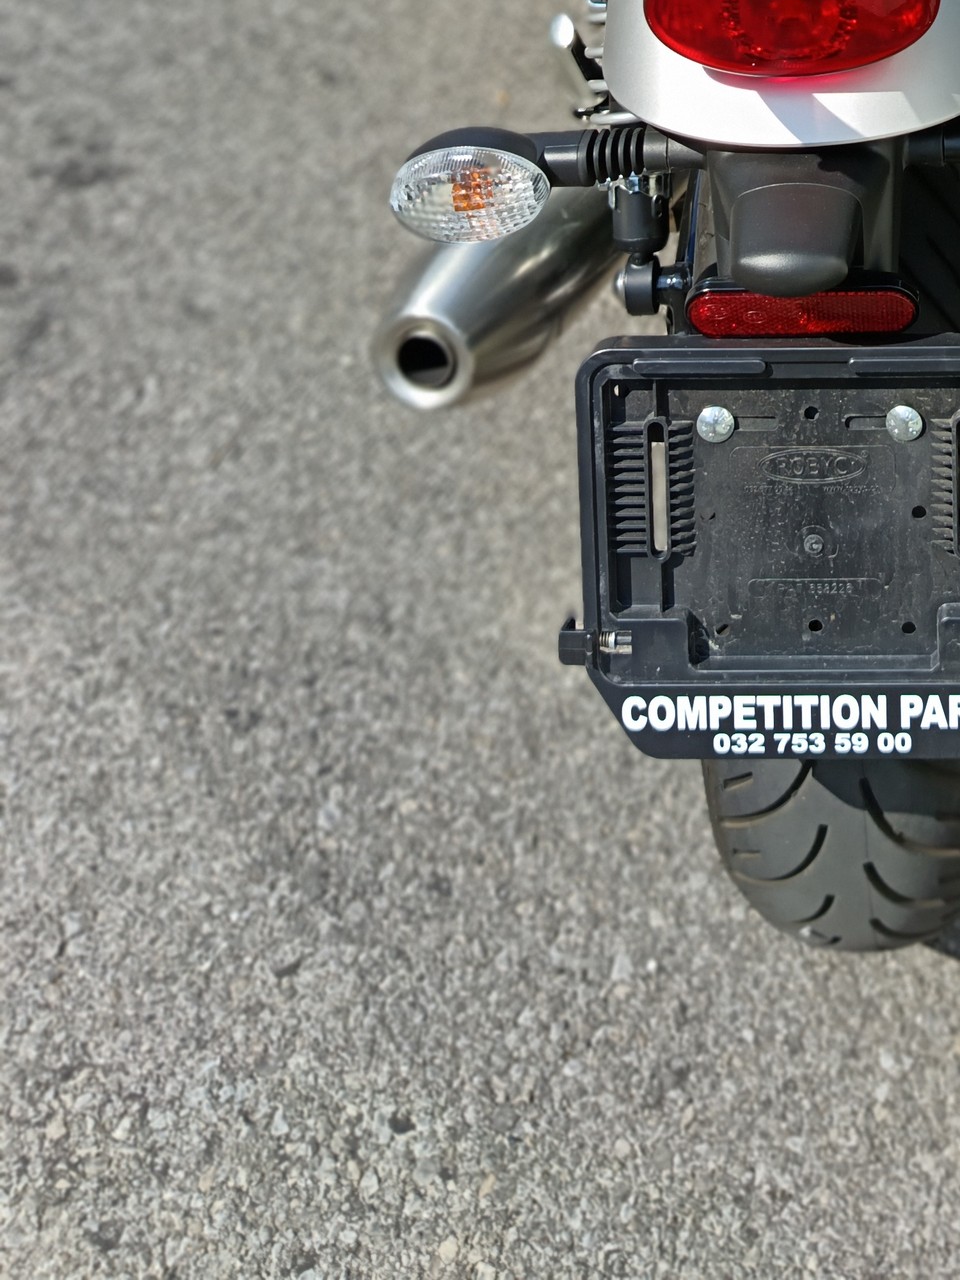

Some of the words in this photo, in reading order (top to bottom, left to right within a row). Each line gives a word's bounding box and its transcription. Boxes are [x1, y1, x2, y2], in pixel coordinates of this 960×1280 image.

[621, 694, 887, 732] COMPETITION
[712, 732, 766, 755] 032
[774, 732, 826, 755] 753
[833, 732, 869, 755] 59
[876, 732, 913, 755] 00
